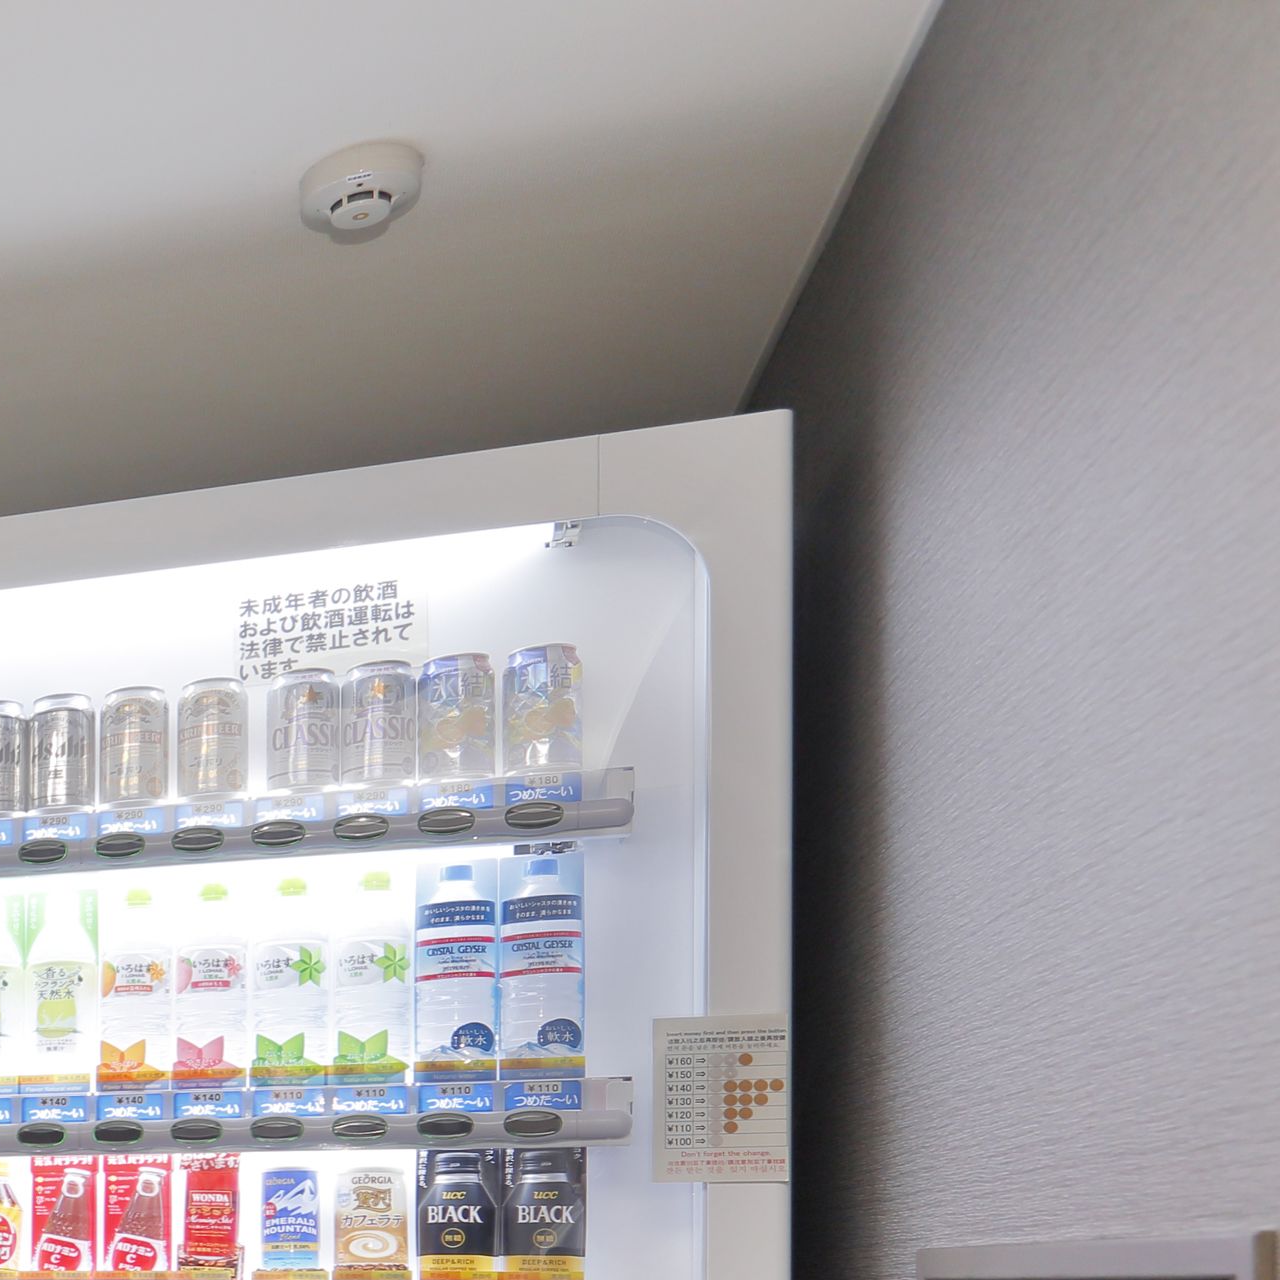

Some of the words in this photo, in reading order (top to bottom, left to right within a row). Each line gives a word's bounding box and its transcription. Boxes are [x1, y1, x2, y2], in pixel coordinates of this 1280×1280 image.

[239, 580, 399, 617] 未成年者の飲酒
[239, 600, 415, 638] および飲酒運転は
[239, 622, 413, 661] 法律で禁止されて
[343, 717, 415, 747] CLASSIC
[528, 775, 558, 786] ¥180
[41, 816, 68, 825] ¥290
[426, 946, 455, 956] CRYSTAL
[458, 944, 487, 954] GEYSER
[512, 941, 541, 952] CRYSTAL
[543, 940, 574, 949] GEYSER
[38, 988, 75, 1000] 天然水
[460, 1035, 487, 1046] 軟水
[547, 1032, 574, 1042] 軟水
[668, 1057, 691, 1065] ¥160
[273, 1090, 303, 1100] ¥110
[440, 1086, 471, 1096] ¥110
[41, 1097, 67, 1107] ¥140
[193, 1093, 221, 1103] ¥140
[668, 1098, 691, 1106] ¥130
[192, 1193, 229, 1203] WONDA
[427, 1205, 483, 1224] BLACK
[517, 1205, 575, 1224] BLACK
[265, 1217, 315, 1227] EMERALD
[342, 1214, 403, 1227] カフェラテ
[264, 1226, 317, 1236] MOUNTAIN
[51, 1254, 61, 1264] C
